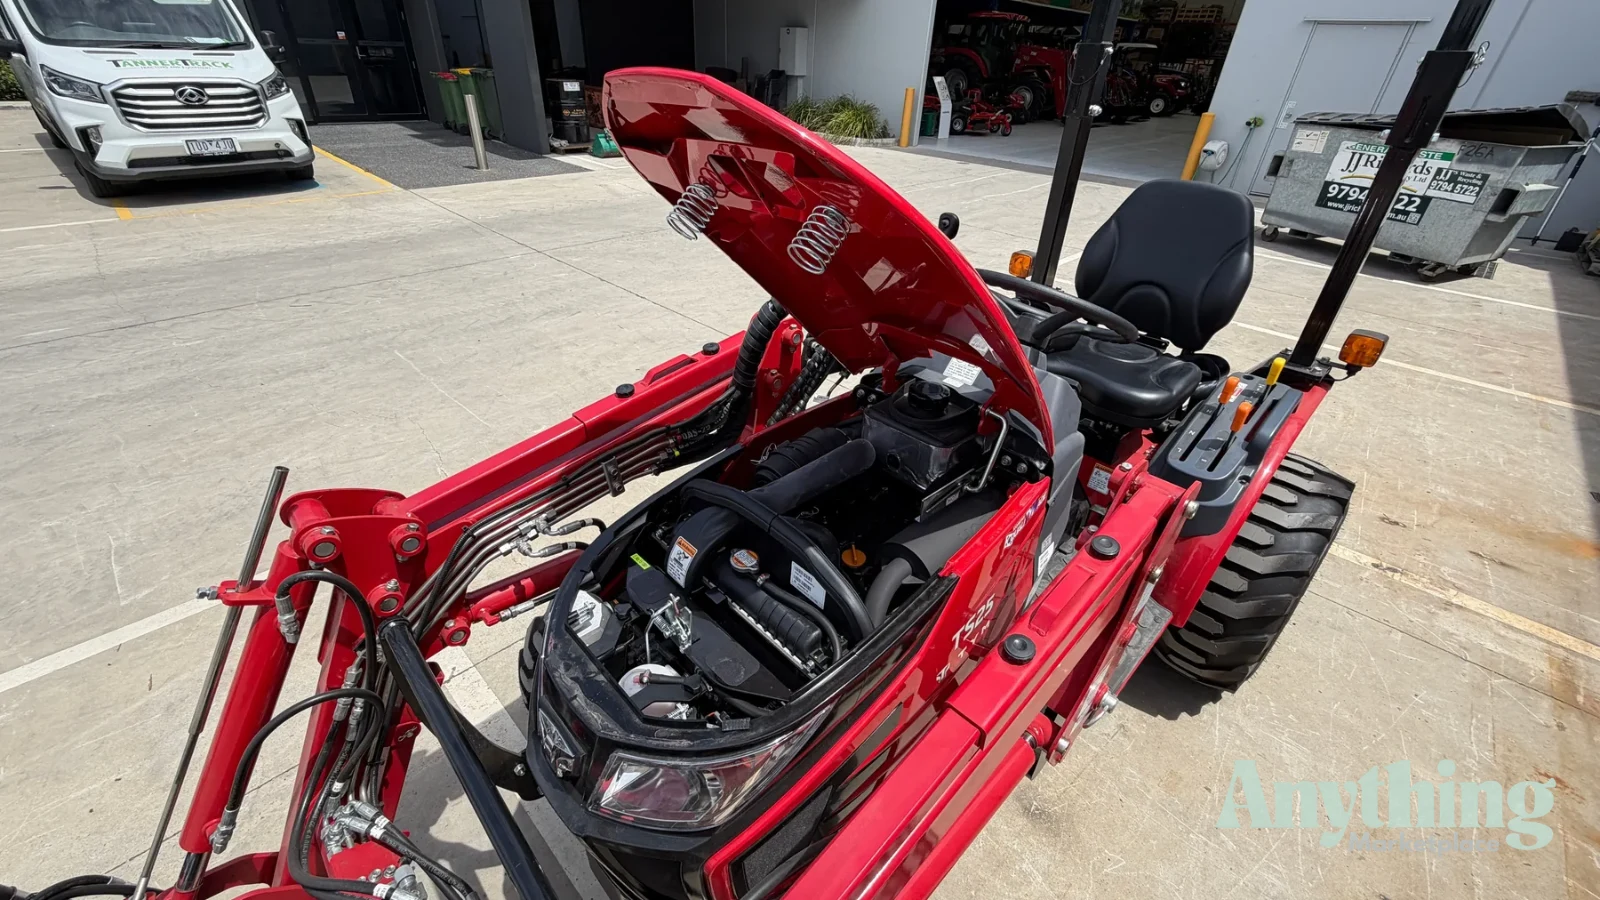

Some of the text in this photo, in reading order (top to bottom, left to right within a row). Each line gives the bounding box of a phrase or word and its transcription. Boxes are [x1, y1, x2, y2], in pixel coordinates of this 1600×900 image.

[1430, 180, 1479, 196] 9794 5722
[951, 593, 996, 650] TS25
